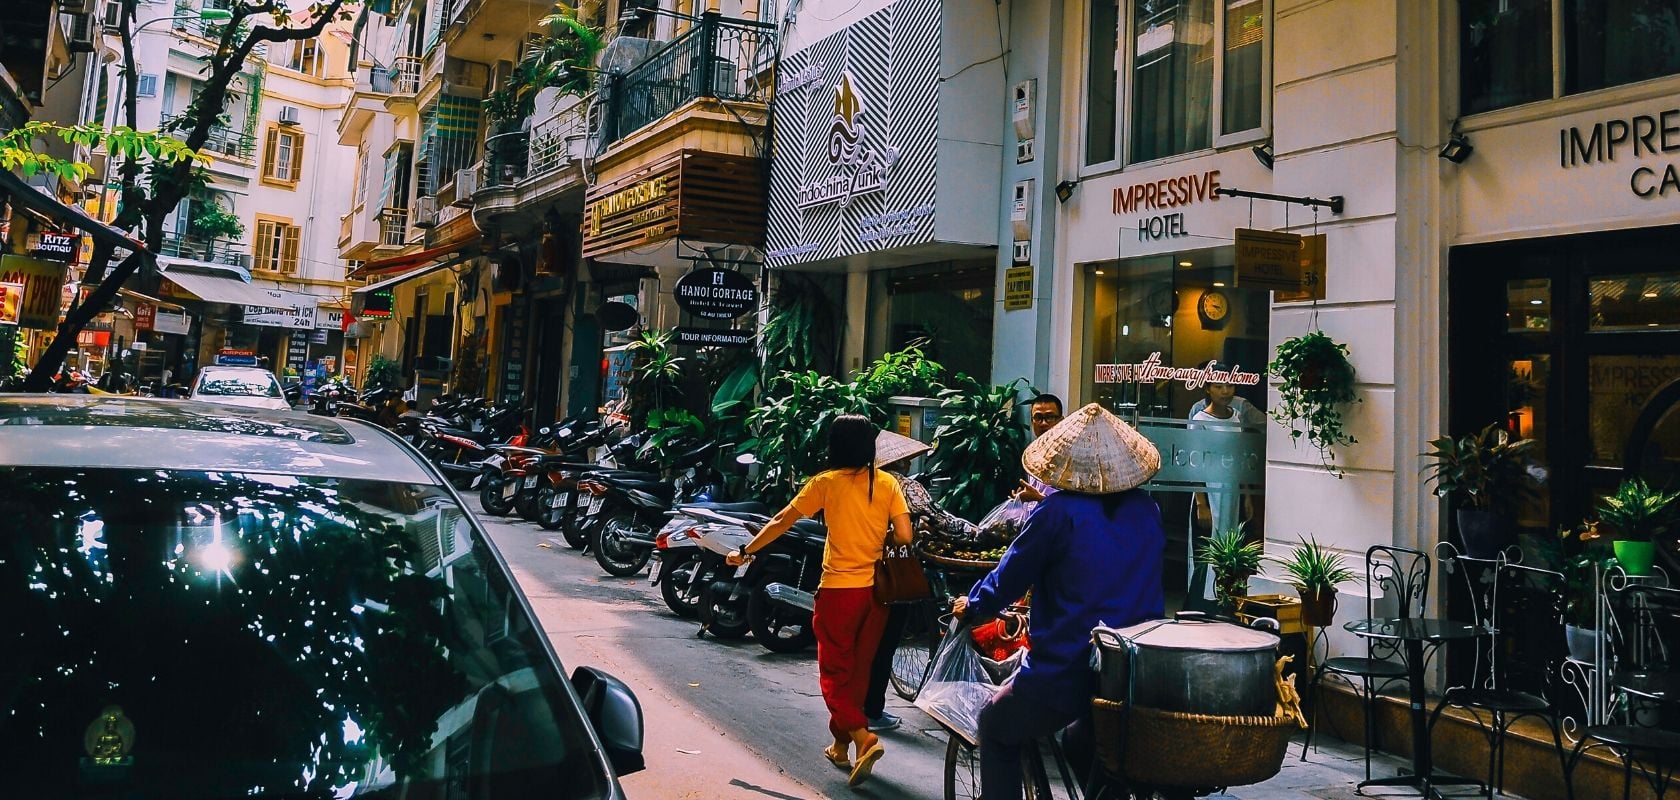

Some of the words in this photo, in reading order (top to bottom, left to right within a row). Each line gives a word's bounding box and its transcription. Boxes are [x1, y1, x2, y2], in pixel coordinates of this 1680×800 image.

[1560, 109, 1680, 168] IMPRE
[1630, 164, 1680, 198] CA
[1112, 170, 1221, 216] IMPRESSIVE
[1138, 212, 1188, 241] HOTEL
[44, 234, 71, 246] RITZ
[1242, 246, 1297, 263] IMPRESSIVE
[1254, 263, 1283, 275] HOTEL
[681, 285, 710, 298] HANOI
[712, 287, 754, 301] GORTAGE
[293, 317, 311, 327] 24h
[680, 332, 700, 341] TOUR
[700, 334, 748, 344] INFORMATION
[1141, 351, 1176, 382] Home
[1174, 366, 1204, 391] away
[1199, 359, 1230, 389] from
[1228, 364, 1261, 386] home
